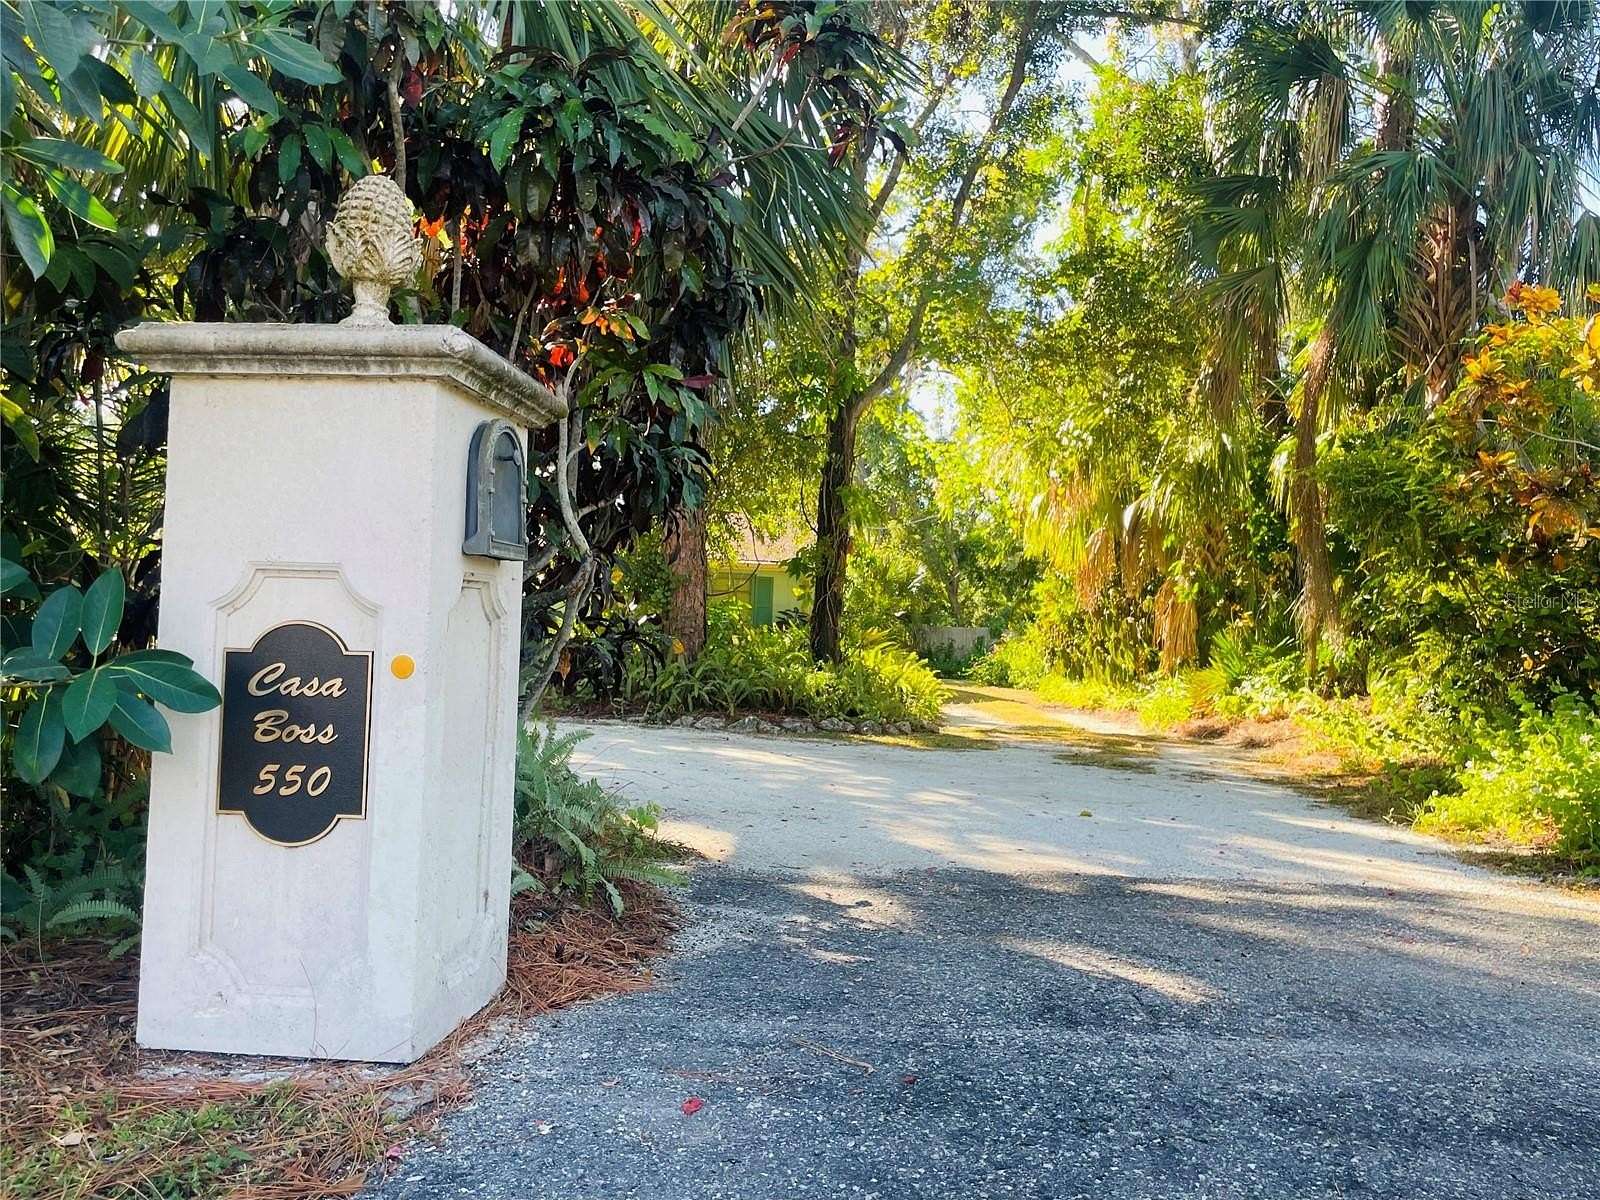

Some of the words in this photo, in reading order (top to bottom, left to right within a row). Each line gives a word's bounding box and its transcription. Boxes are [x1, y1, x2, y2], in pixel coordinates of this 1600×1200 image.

[247, 662, 347, 698] Casa
[252, 709, 339, 745] Boss
[252, 763, 332, 797] 550
